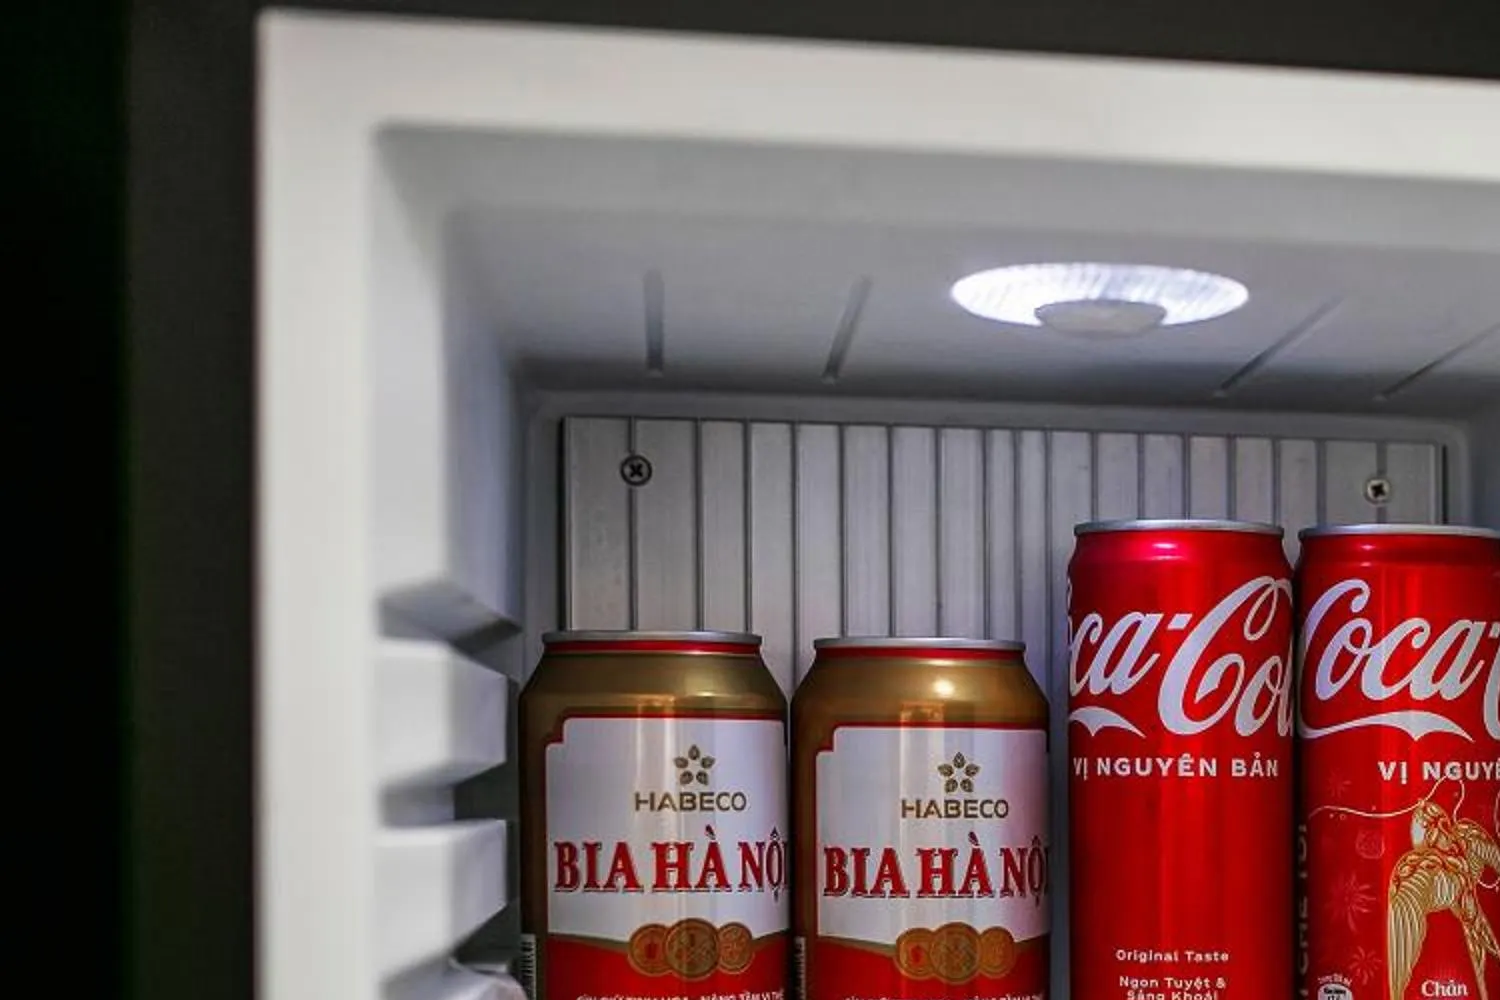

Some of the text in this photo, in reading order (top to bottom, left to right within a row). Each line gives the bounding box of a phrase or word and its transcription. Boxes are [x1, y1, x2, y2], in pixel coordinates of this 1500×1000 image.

[1073, 752, 1279, 781] VỊ NGUYÊN BẢN
[1377, 761, 1407, 785] VỊ
[635, 791, 747, 812] HABECO
[901, 798, 1009, 819] HABECO
[553, 841, 645, 893] BIA
[651, 824, 732, 893] HÀ
[823, 846, 910, 898] BIA
[915, 831, 995, 899] HÀ
[1115, 949, 1229, 964] Original Taste
[1119, 976, 1158, 989] Ngon
[1216, 977, 1226, 989] &
